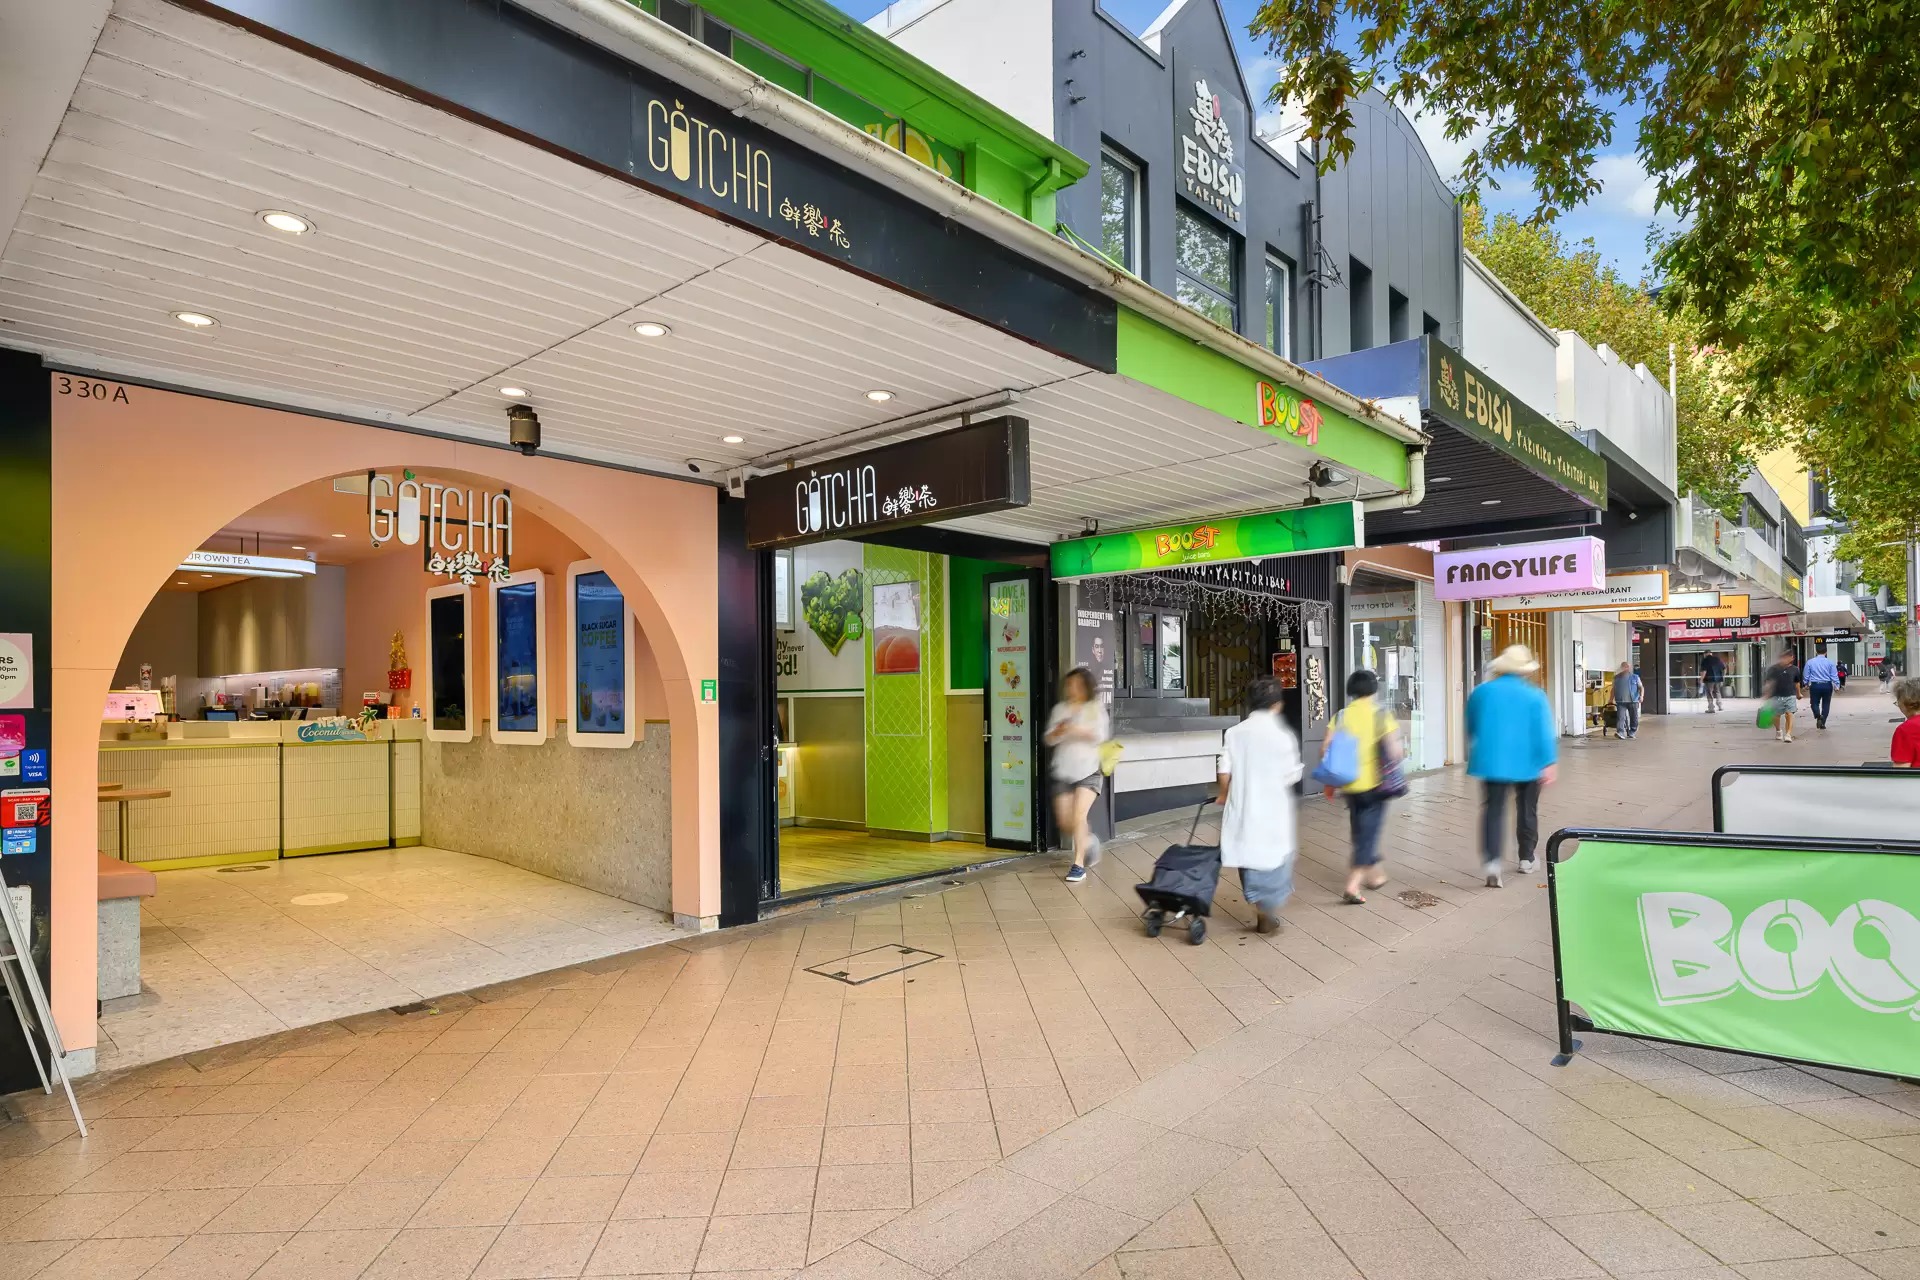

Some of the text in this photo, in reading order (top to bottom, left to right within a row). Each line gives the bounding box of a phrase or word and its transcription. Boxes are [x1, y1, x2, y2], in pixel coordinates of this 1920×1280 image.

[648, 99, 772, 218] GOTCHA
[1181, 134, 1242, 207] EBISU
[1256, 381, 1324, 446] BOOST
[1464, 370, 1512, 443] EBISU
[370, 474, 513, 556] GOTCHA
[796, 464, 877, 535] GOTCHA
[1156, 525, 1221, 557] BOOST
[204, 554, 229, 563] OWN
[232, 556, 251, 565] TEA
[1446, 553, 1577, 584] FANCYLIFE
[582, 630, 617, 648] COFFEE
[848, 623, 859, 633] LIFE
[1690, 618, 1741, 628] SUSHI HUB
[301, 726, 342, 738] Coconut
